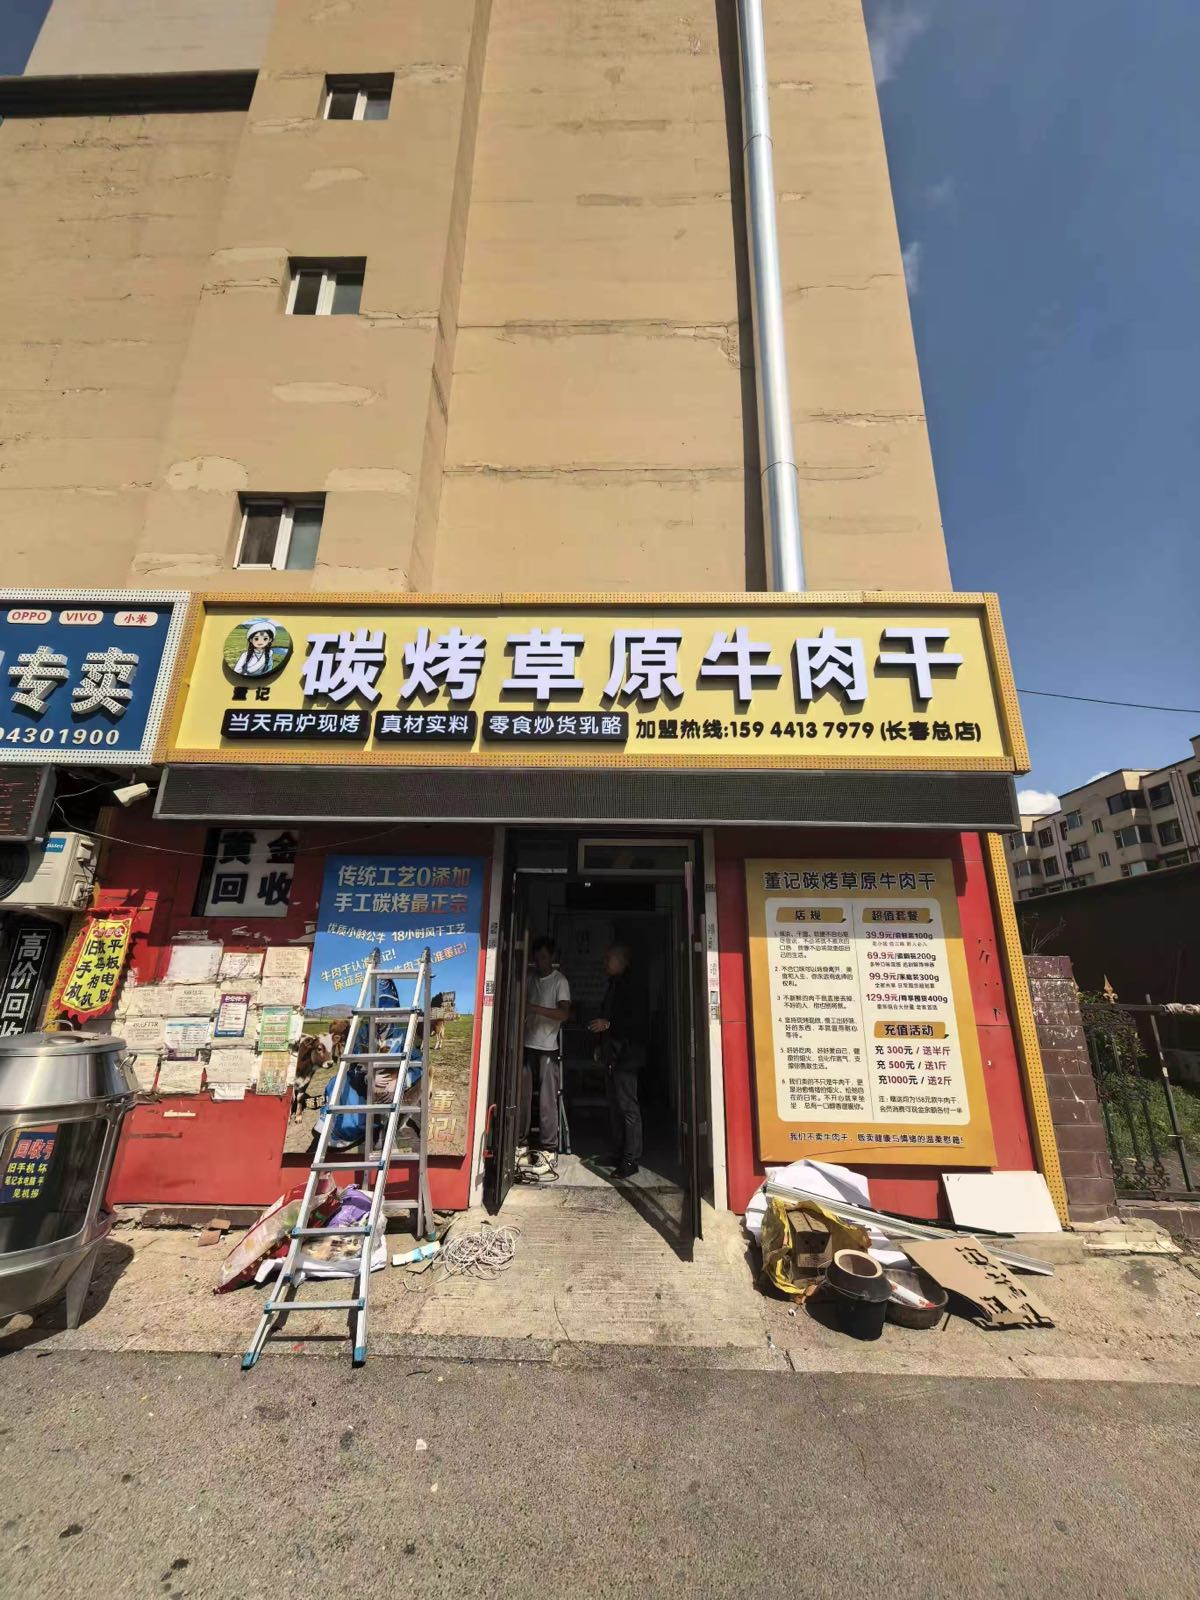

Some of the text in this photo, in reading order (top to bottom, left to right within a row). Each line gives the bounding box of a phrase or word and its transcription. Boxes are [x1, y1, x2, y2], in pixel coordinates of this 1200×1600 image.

[11, 611, 97, 622] OPPO VIVO
[124, 613, 148, 625] 小米
[302, 626, 964, 703] 碳烤草原牛肉干
[0, 645, 139, 717] 专卖
[229, 712, 361, 735] 当天吊炉现烤
[380, 713, 469, 734] 真材实料
[488, 713, 623, 736] 零食炒货乳酪
[219, 831, 298, 865] 黄金
[338, 865, 472, 887] 传统工艺0添加
[764, 871, 936, 891] 董记碳烤草原牛肉干
[211, 873, 294, 906] 回收
[334, 892, 469, 914] 手工碳烤最正宗
[871, 910, 919, 922] 超值套餐
[327, 922, 387, 944] 优质小龄公牛
[391, 922, 466, 942] 18小时风干工艺
[884, 1024, 934, 1037] 充值活动
